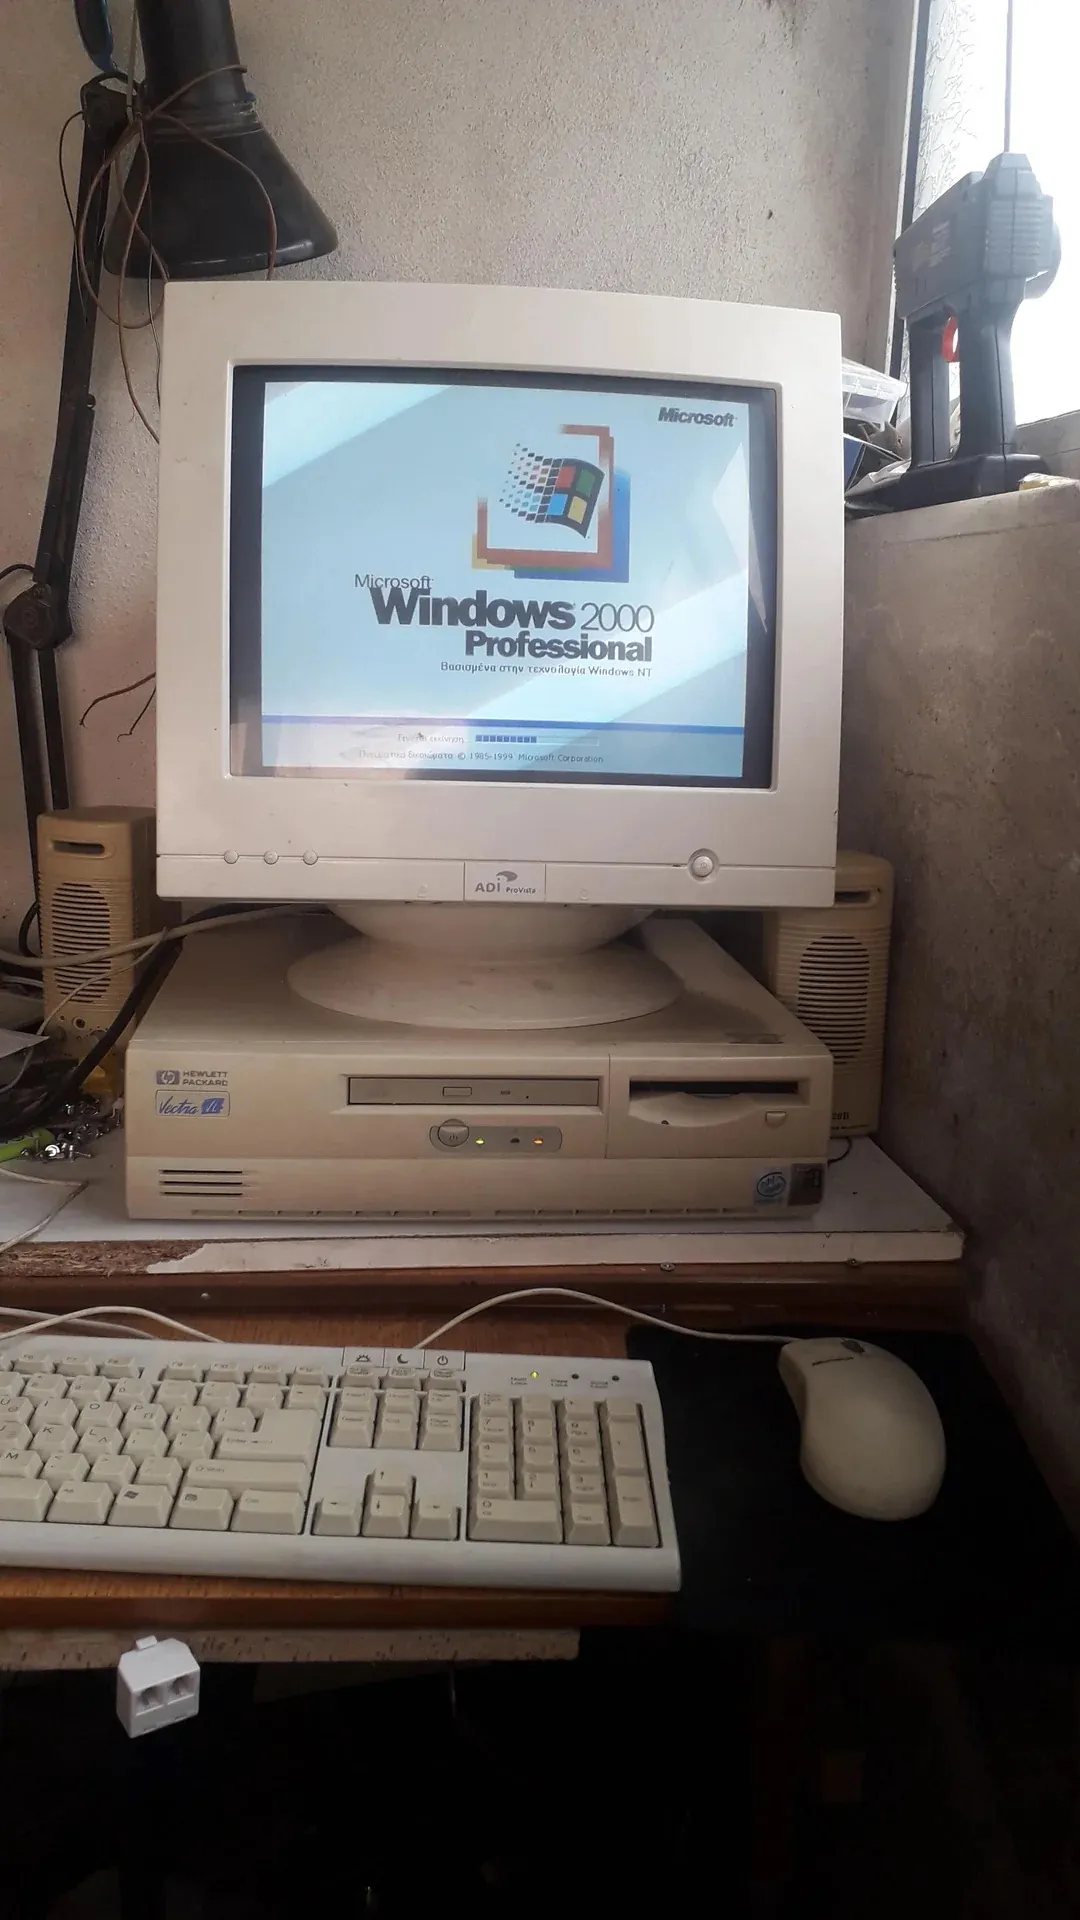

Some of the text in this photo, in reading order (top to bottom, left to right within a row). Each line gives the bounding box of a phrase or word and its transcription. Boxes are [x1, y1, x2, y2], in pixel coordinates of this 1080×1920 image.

[658, 406, 736, 428] Microsoft
[354, 573, 433, 590] Microsoft
[369, 586, 655, 633] Windows 2000
[465, 630, 653, 662] Professional
[499, 665, 524, 675] στην
[588, 665, 635, 677] Windows
[637, 667, 653, 678] NT
[518, 753, 555, 762] Microsoft
[557, 754, 605, 764] Corporation
[182, 1070, 229, 1078] HEWLETT
[182, 1079, 229, 1087] PACKARD
[159, 1095, 200, 1115] Vectra
